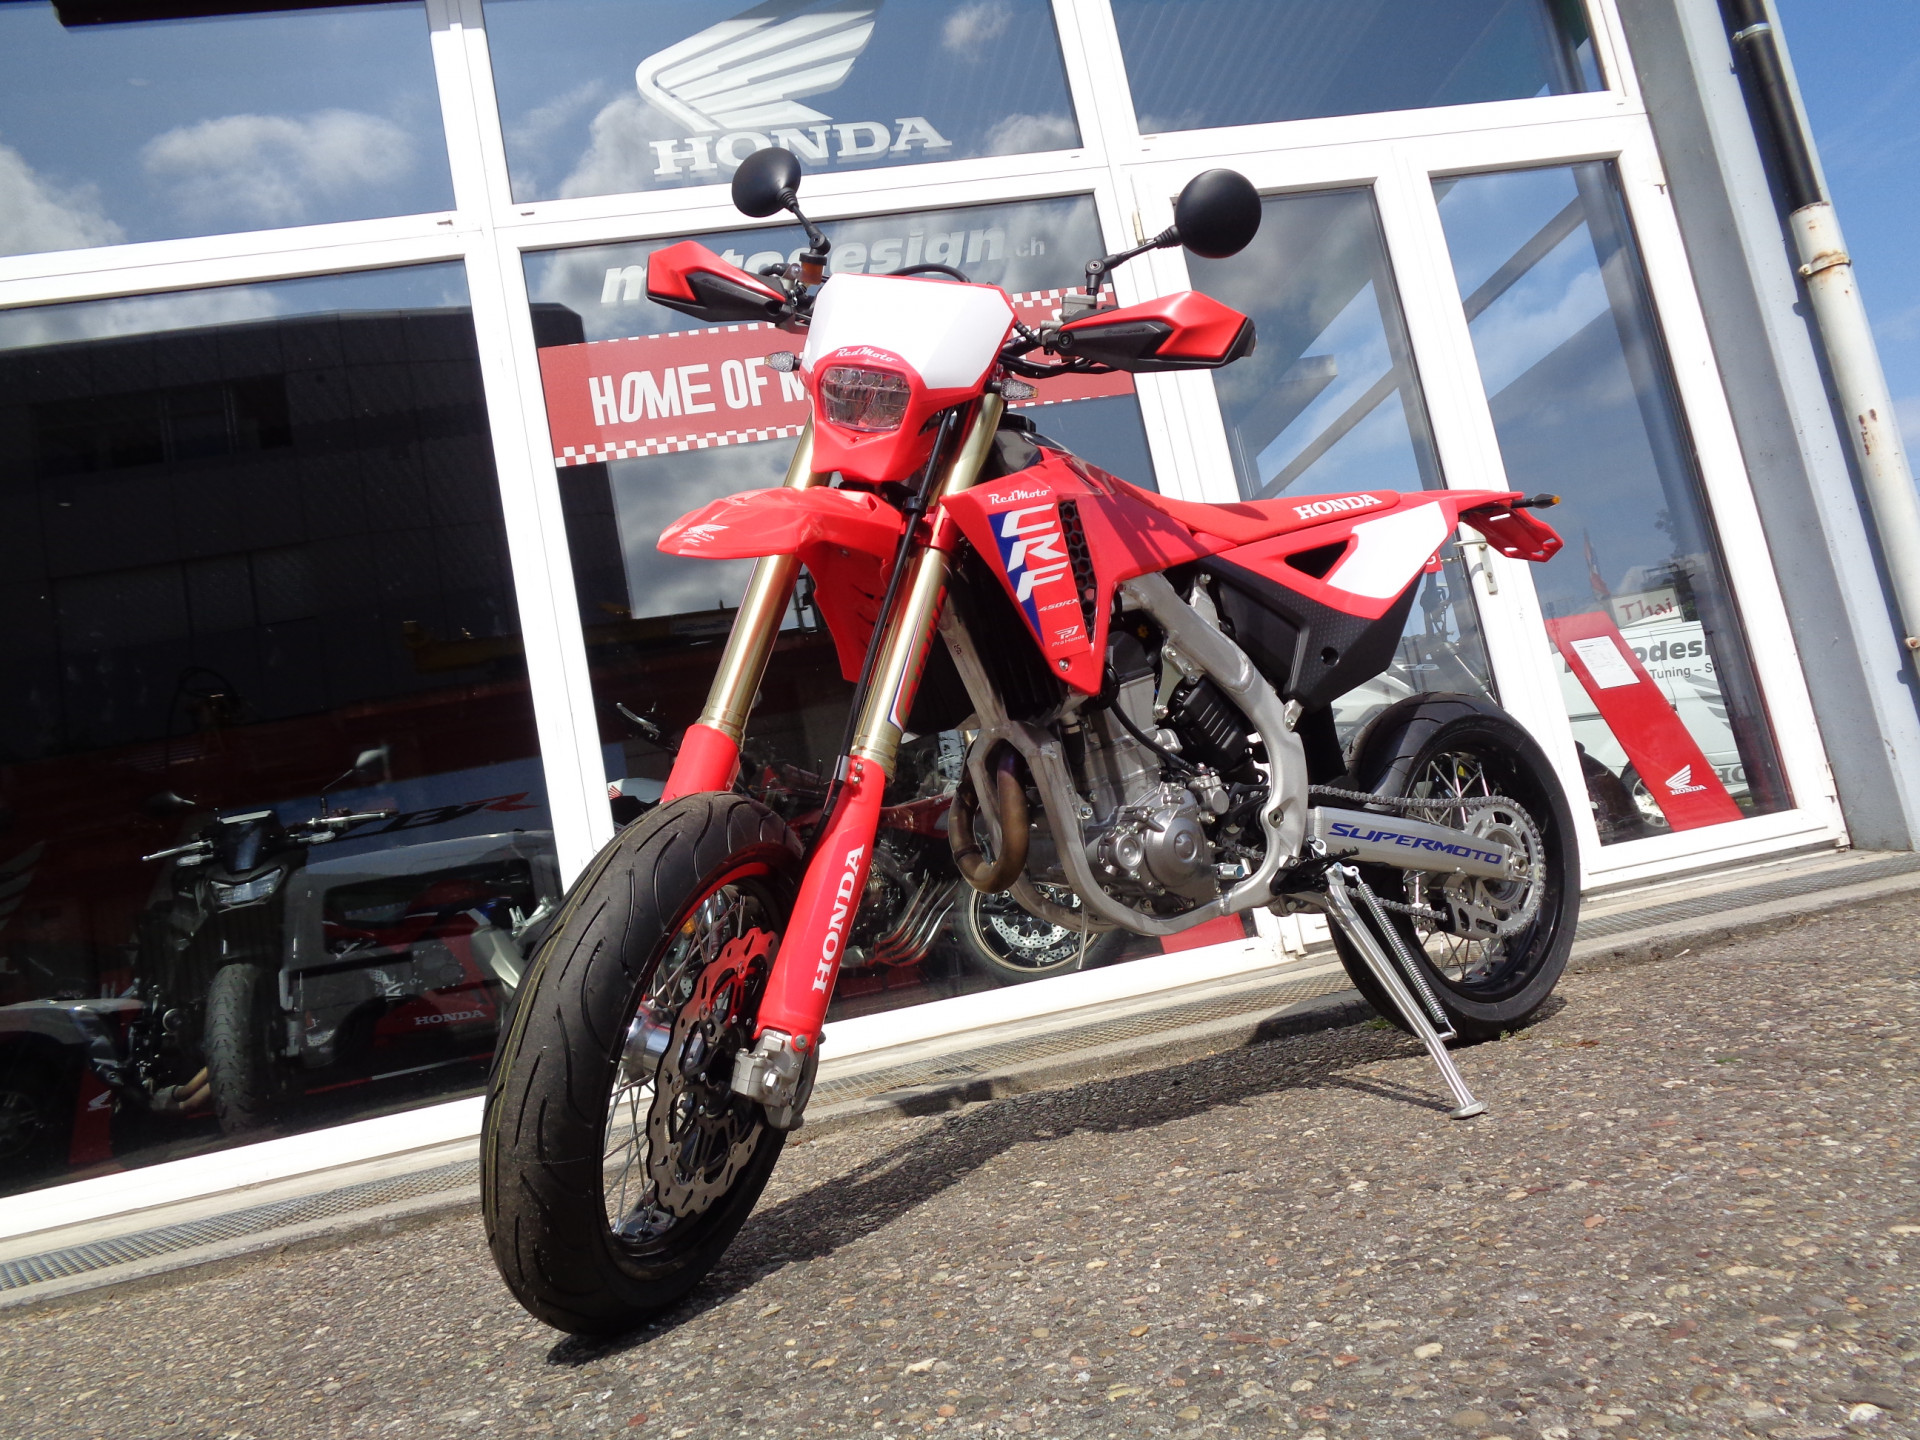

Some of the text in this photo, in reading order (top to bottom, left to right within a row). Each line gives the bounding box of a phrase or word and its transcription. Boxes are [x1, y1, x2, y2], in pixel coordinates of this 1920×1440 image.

[649, 116, 953, 176] HONDA
[720, 356, 768, 410] OF
[1292, 493, 1383, 520] HONDA
[1000, 503, 1068, 604] CRF
[1618, 596, 1673, 621] Thai
[1649, 666, 1691, 680] Tuning
[1670, 784, 1708, 796] HONDA
[1327, 822, 1503, 865] SUPERMOTO
[812, 844, 865, 994] HONDA
[414, 1009, 487, 1026] HONDA
